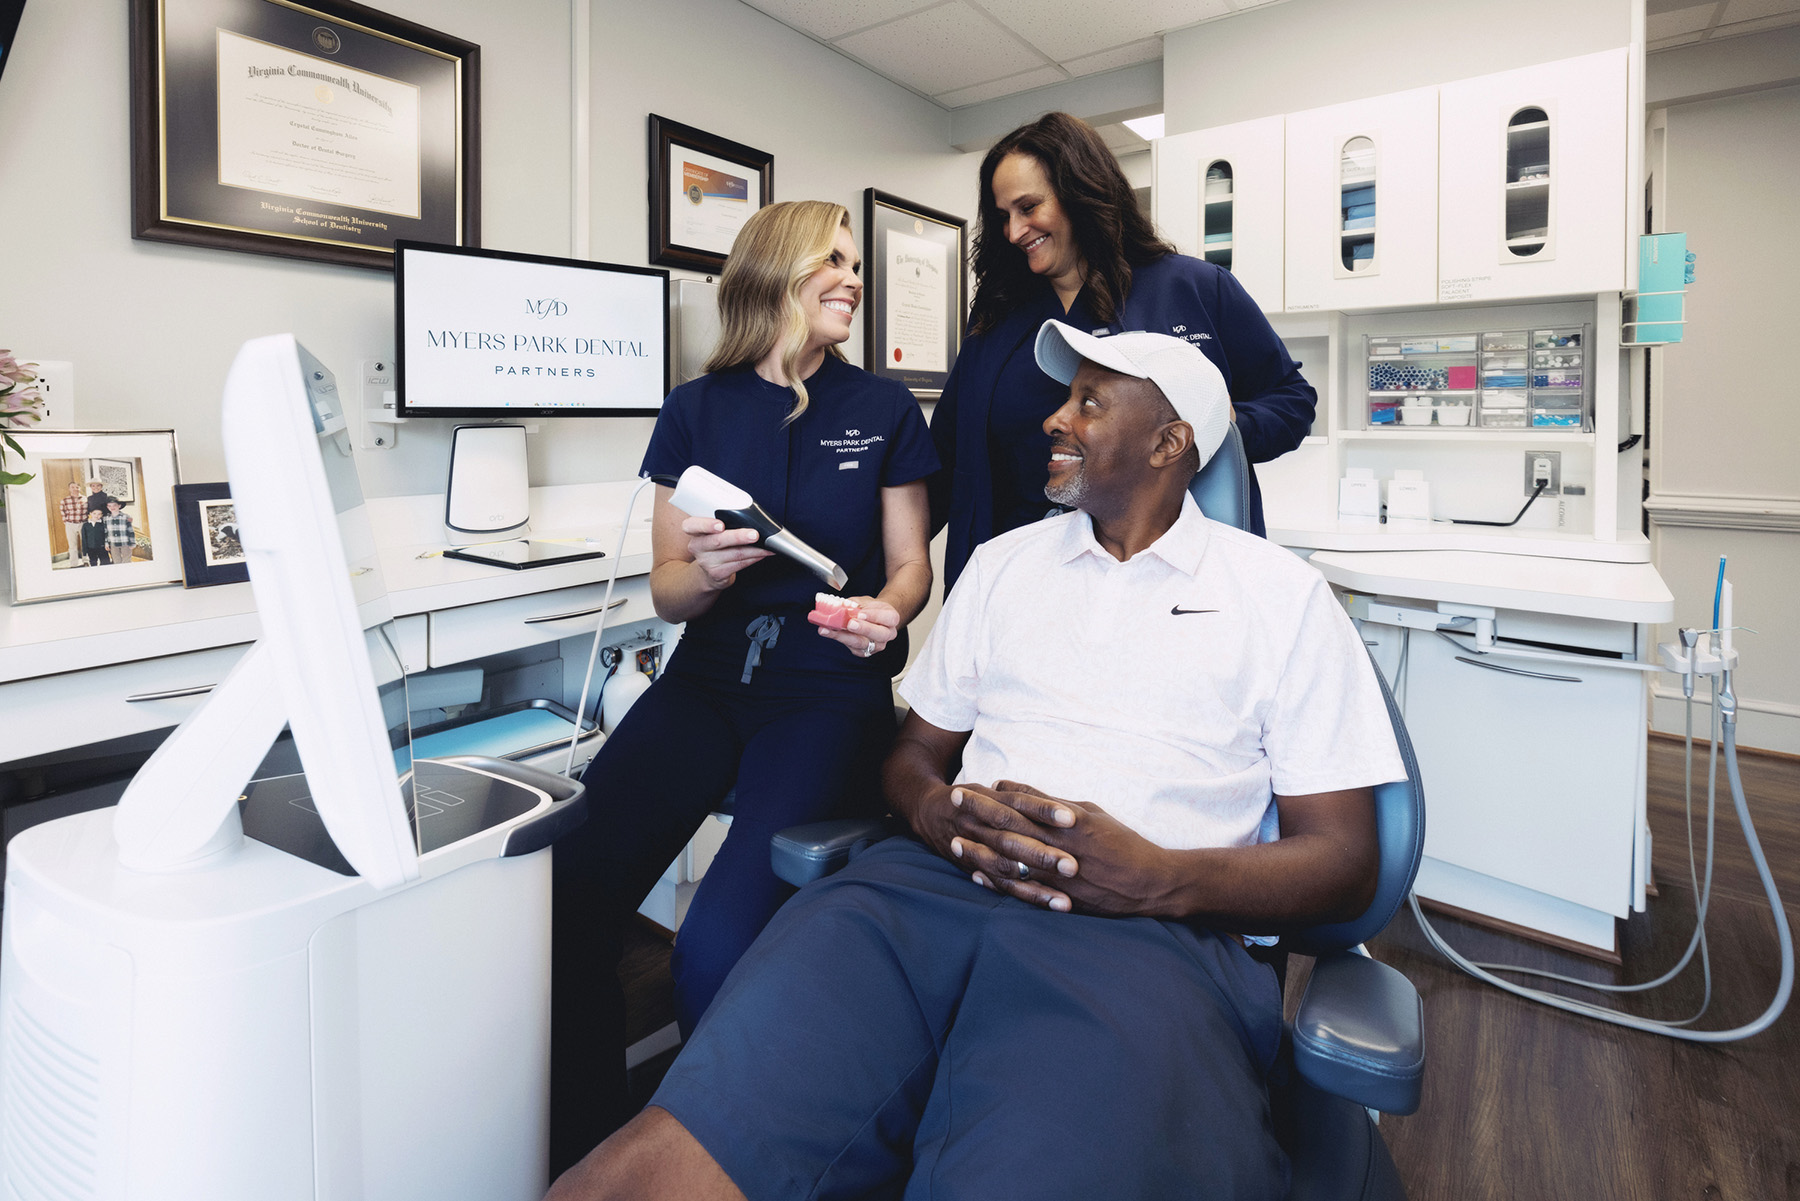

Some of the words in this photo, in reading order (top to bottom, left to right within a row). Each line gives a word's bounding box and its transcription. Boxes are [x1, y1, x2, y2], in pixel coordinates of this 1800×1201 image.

[247, 65, 285, 79] Virginia
[287, 64, 352, 93] Commonwealth
[352, 80, 393, 118] University
[260, 201, 294, 213] Virginia
[295, 207, 350, 224] Commonwealth
[351, 216, 388, 231] University
[292, 215, 319, 226] School
[329, 221, 362, 234] Dentistry
[427, 329, 506, 351] MYERS
[514, 334, 567, 354] PARK
[575, 337, 649, 358] DENTAL
[1189, 333, 1212, 341] DENTAL
[495, 365, 596, 378] PARTNERS
[820, 439, 842, 447] MYERS
[861, 435, 885, 445] DENTAL
